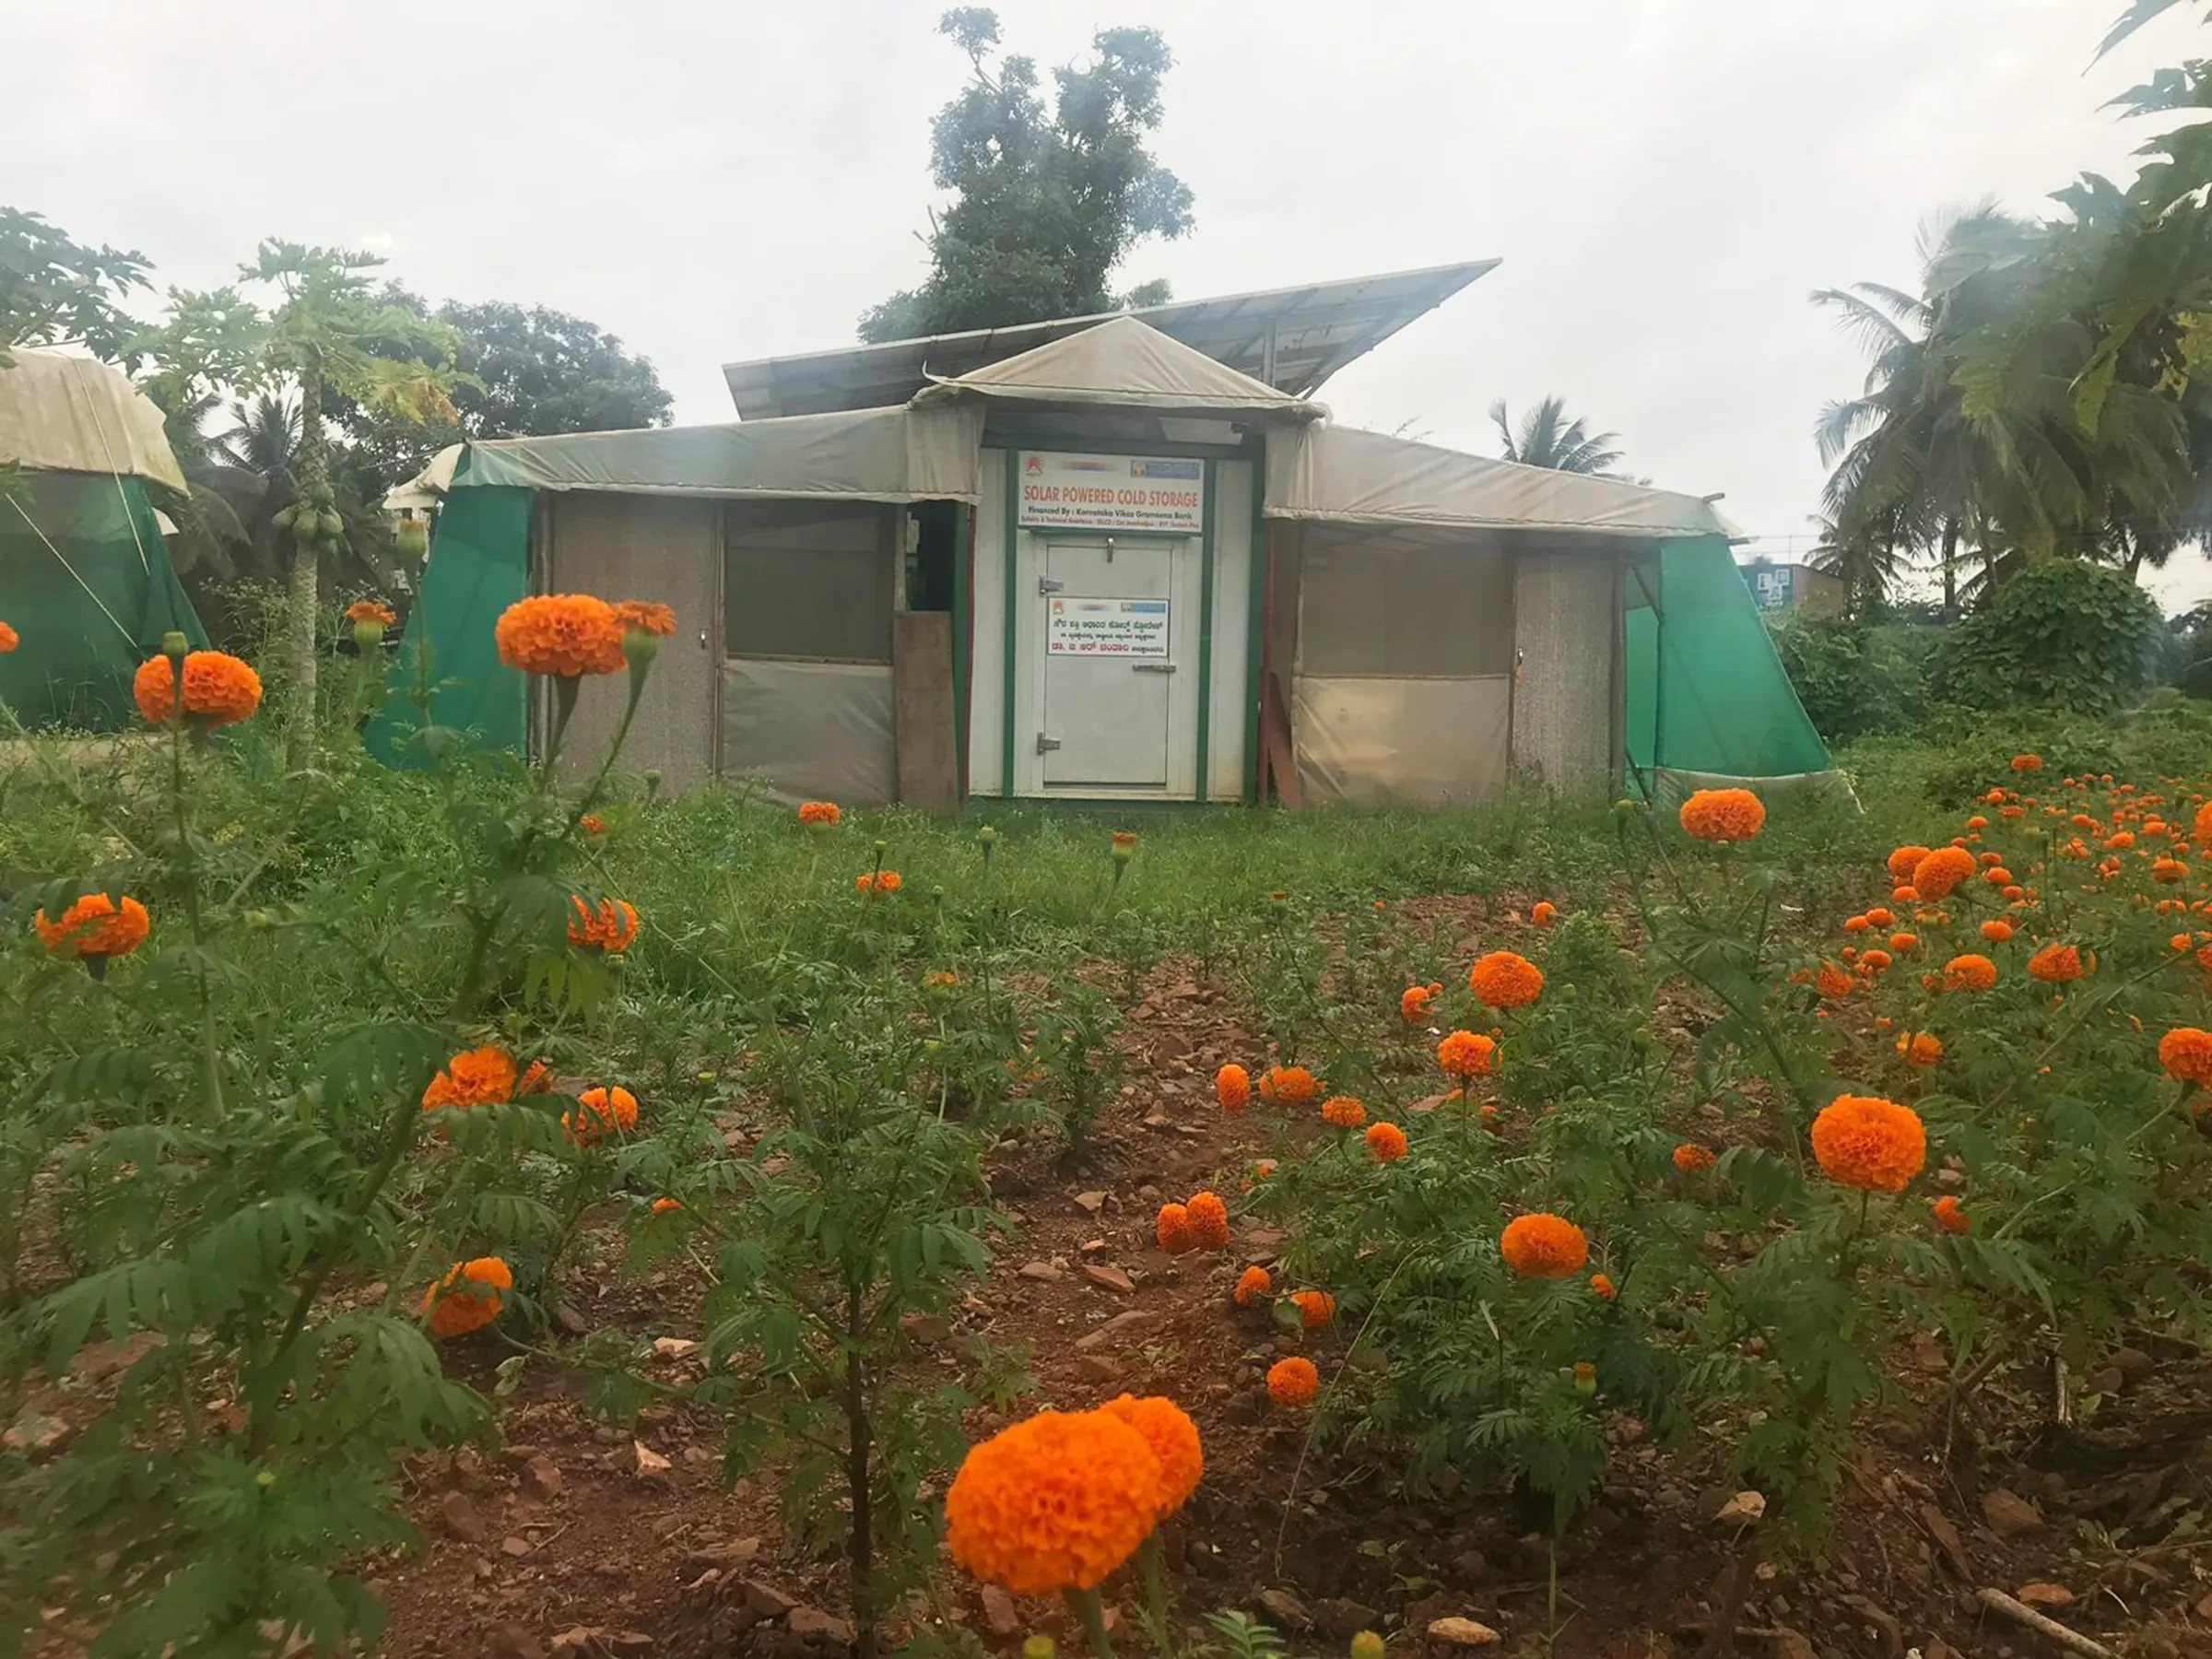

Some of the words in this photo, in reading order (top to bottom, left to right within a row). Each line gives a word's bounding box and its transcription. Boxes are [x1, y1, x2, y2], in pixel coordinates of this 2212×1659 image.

[1024, 485, 1060, 502] SOLAR
[1063, 488, 1114, 504] POWERED
[1118, 488, 1147, 506] COLD
[1149, 490, 1198, 508] STORAGE
[1028, 506, 1060, 515] Financed
[1062, 507, 1070, 517] By
[1114, 509, 1134, 518] Vikas
[1175, 512, 1193, 520] Bank
